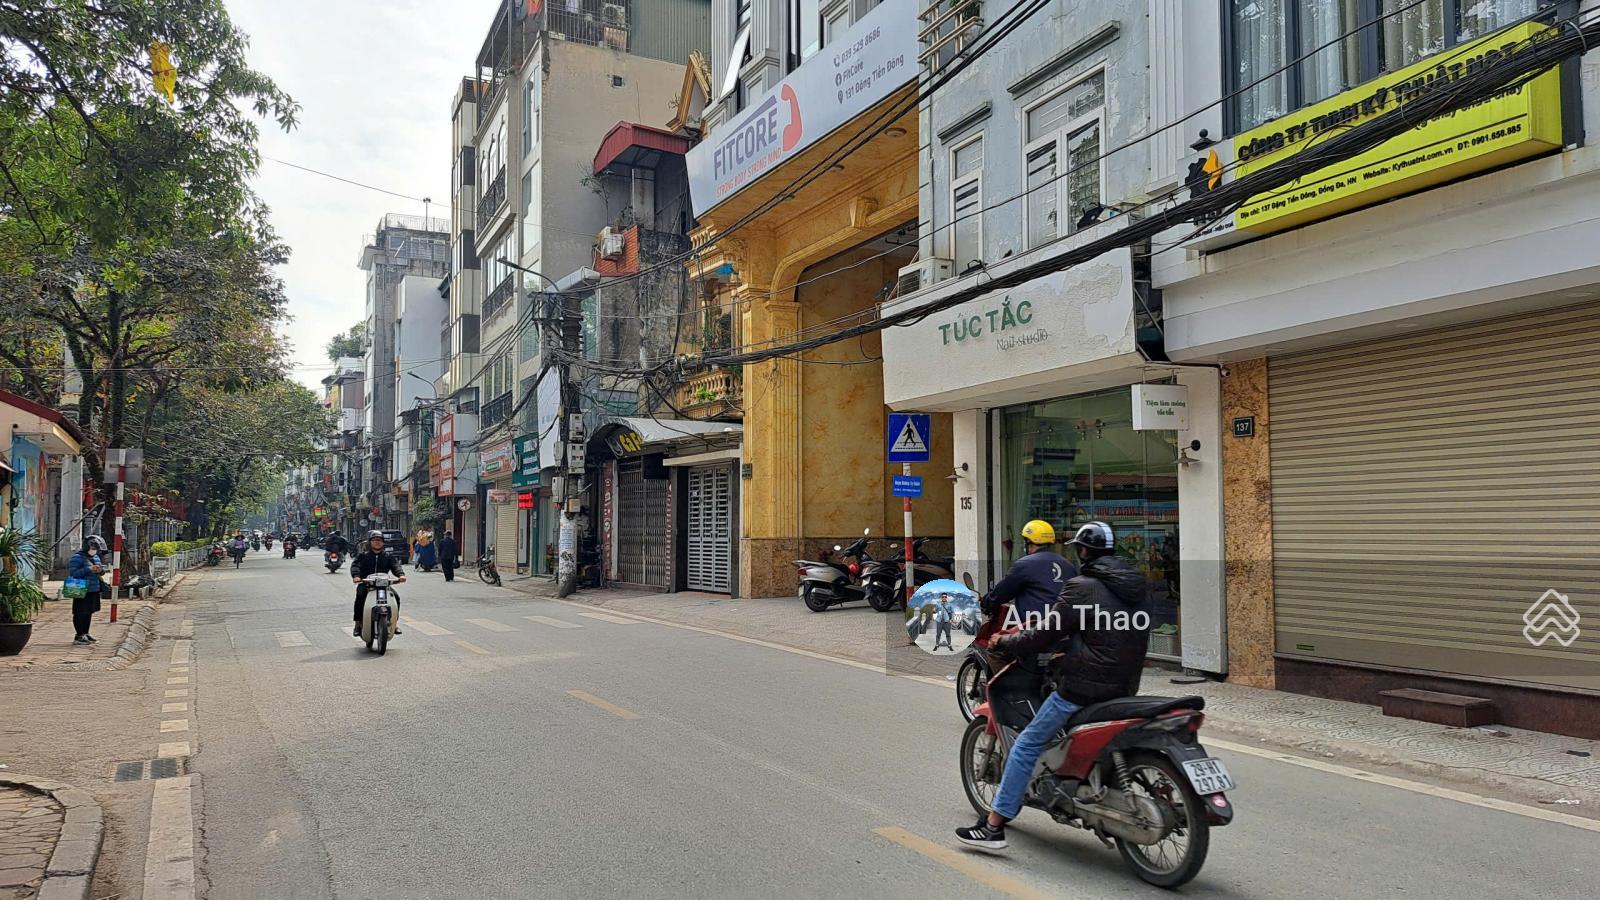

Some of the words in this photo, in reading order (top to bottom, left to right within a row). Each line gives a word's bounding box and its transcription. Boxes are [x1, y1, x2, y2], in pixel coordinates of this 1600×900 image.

[713, 107, 778, 181] FITCORE
[1238, 132, 1284, 161] CÔNG
[1285, 122, 1308, 143] TY
[716, 179, 734, 198] STRONG
[734, 169, 747, 187] BODY
[748, 156, 767, 178] STRONG
[767, 147, 782, 164] MIND
[1261, 203, 1271, 213] 137
[1347, 176, 1357, 186] HN
[1363, 166, 1391, 180] Website:
[985, 295, 1033, 333] TẮC
[1236, 422, 1249, 432] 137
[960, 497, 972, 510] 135
[1189, 760, 1221, 778] 29-H1
